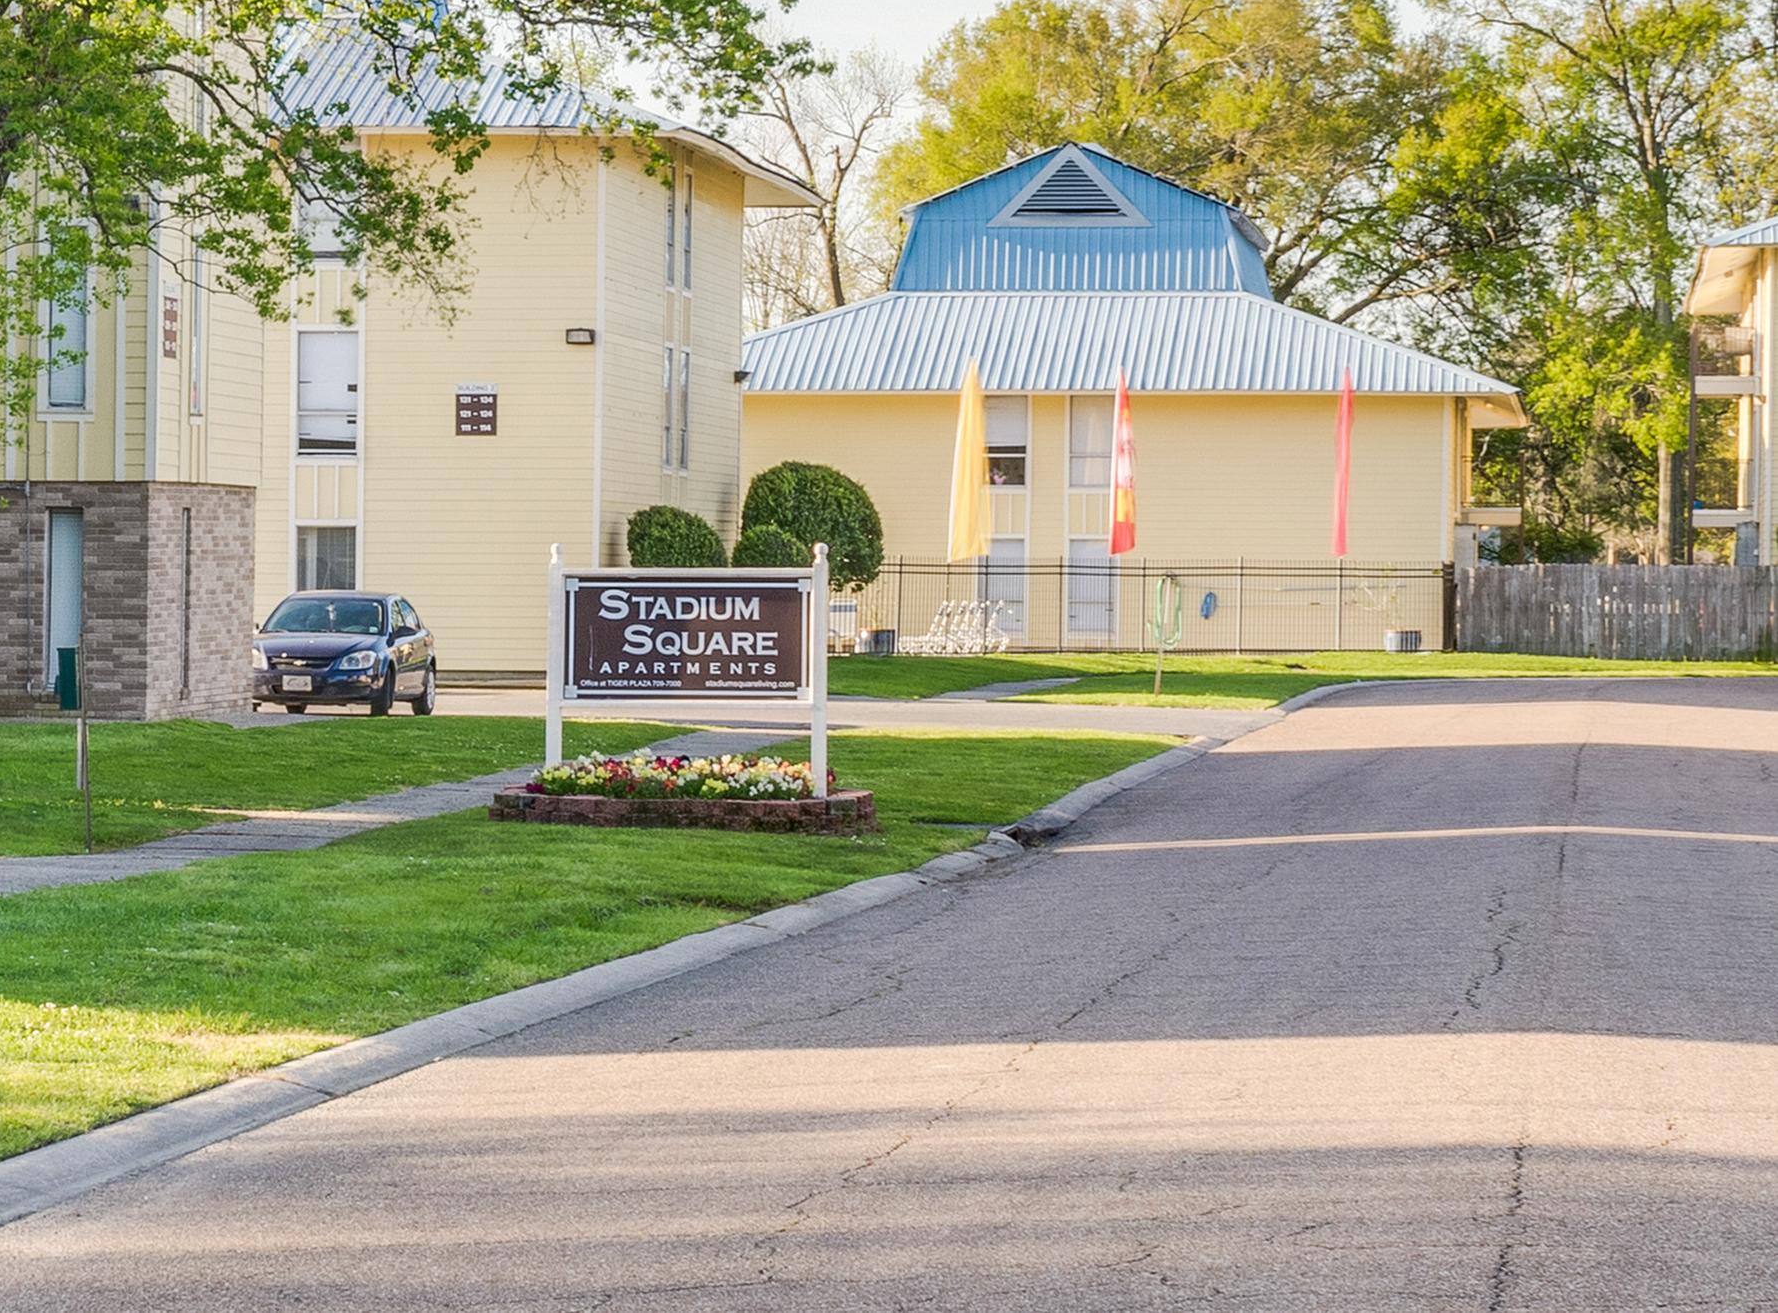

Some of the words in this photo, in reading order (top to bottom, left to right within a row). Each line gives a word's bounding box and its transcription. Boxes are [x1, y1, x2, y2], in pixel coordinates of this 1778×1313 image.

[598, 589, 760, 621] STADIUM
[622, 624, 779, 657] SQUARE
[599, 662, 777, 675] APARTMENTS
[607, 679, 628, 687] TIGER
[629, 679, 652, 687] PLAZA
